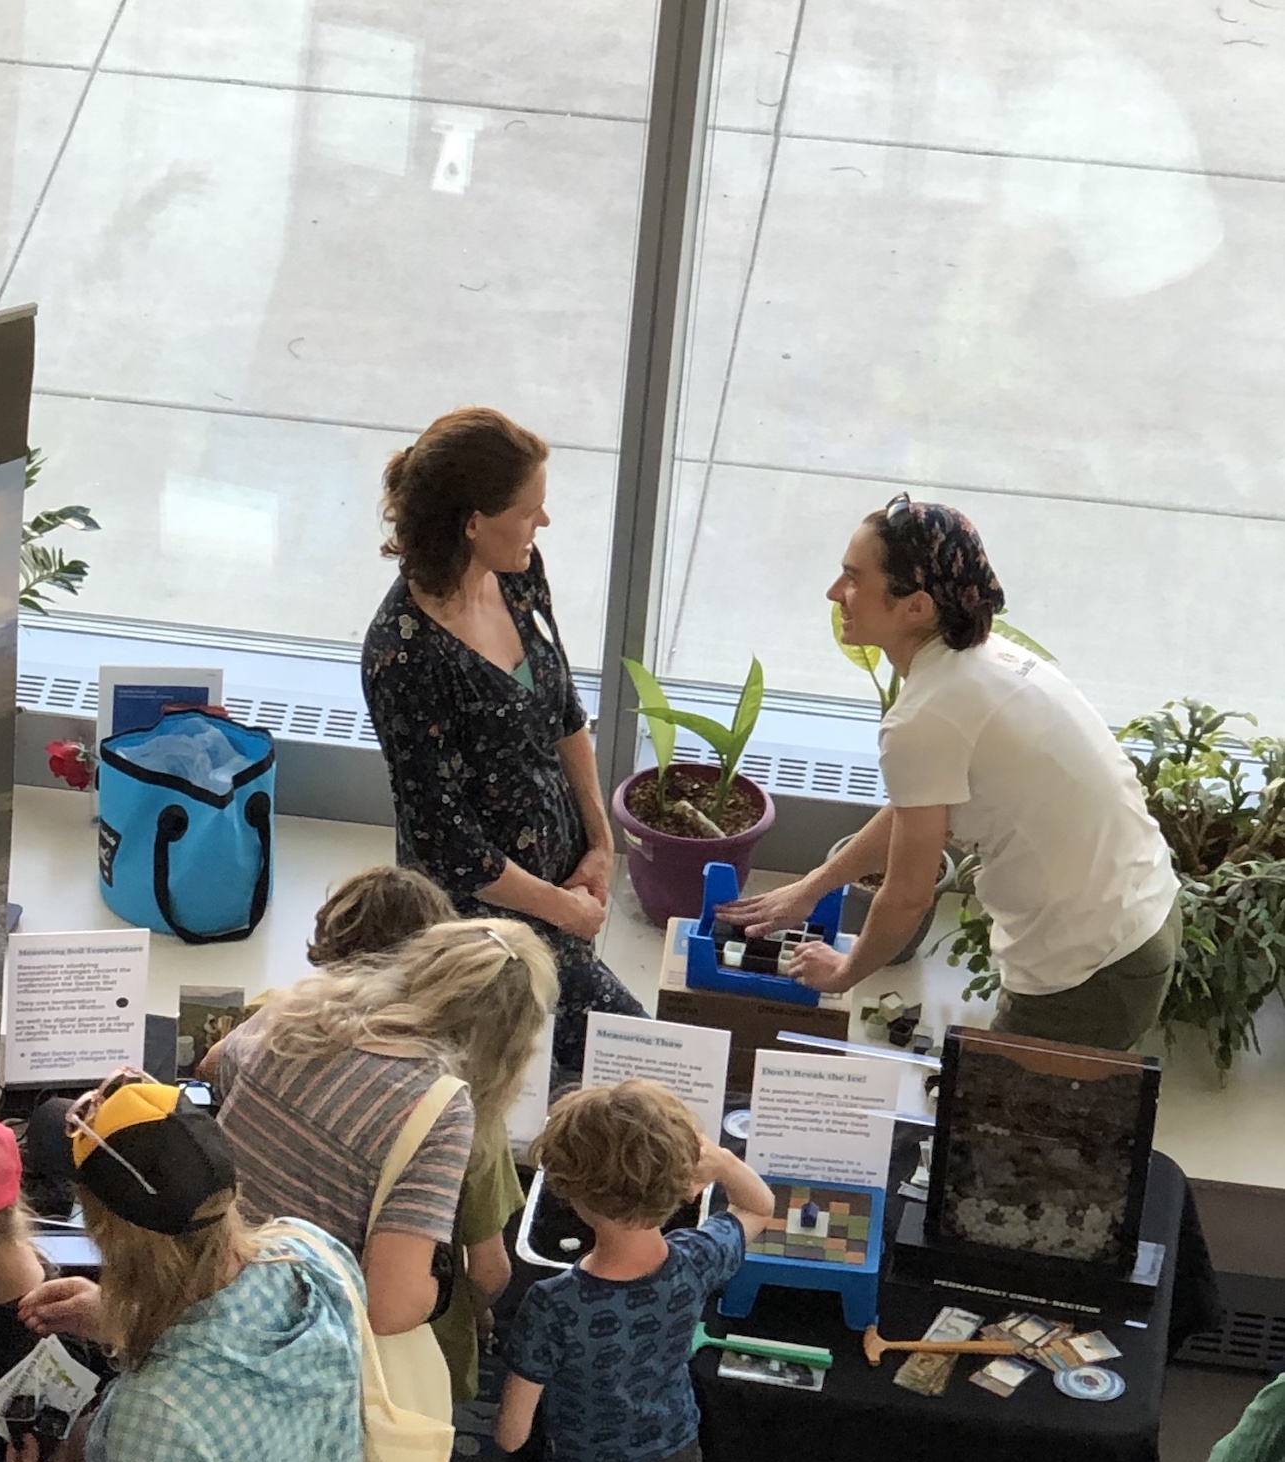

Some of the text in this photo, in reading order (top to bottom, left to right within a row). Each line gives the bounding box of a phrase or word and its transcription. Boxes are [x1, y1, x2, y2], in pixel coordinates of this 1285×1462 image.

[87, 946, 143, 954] Temperature
[596, 1029, 683, 1048] Measuring Thaw
[762, 1067, 791, 1076] Don't
[794, 1070, 824, 1080] Break
[828, 1072, 844, 1082] the
[933, 1279, 1007, 1298] PERMAFROST
